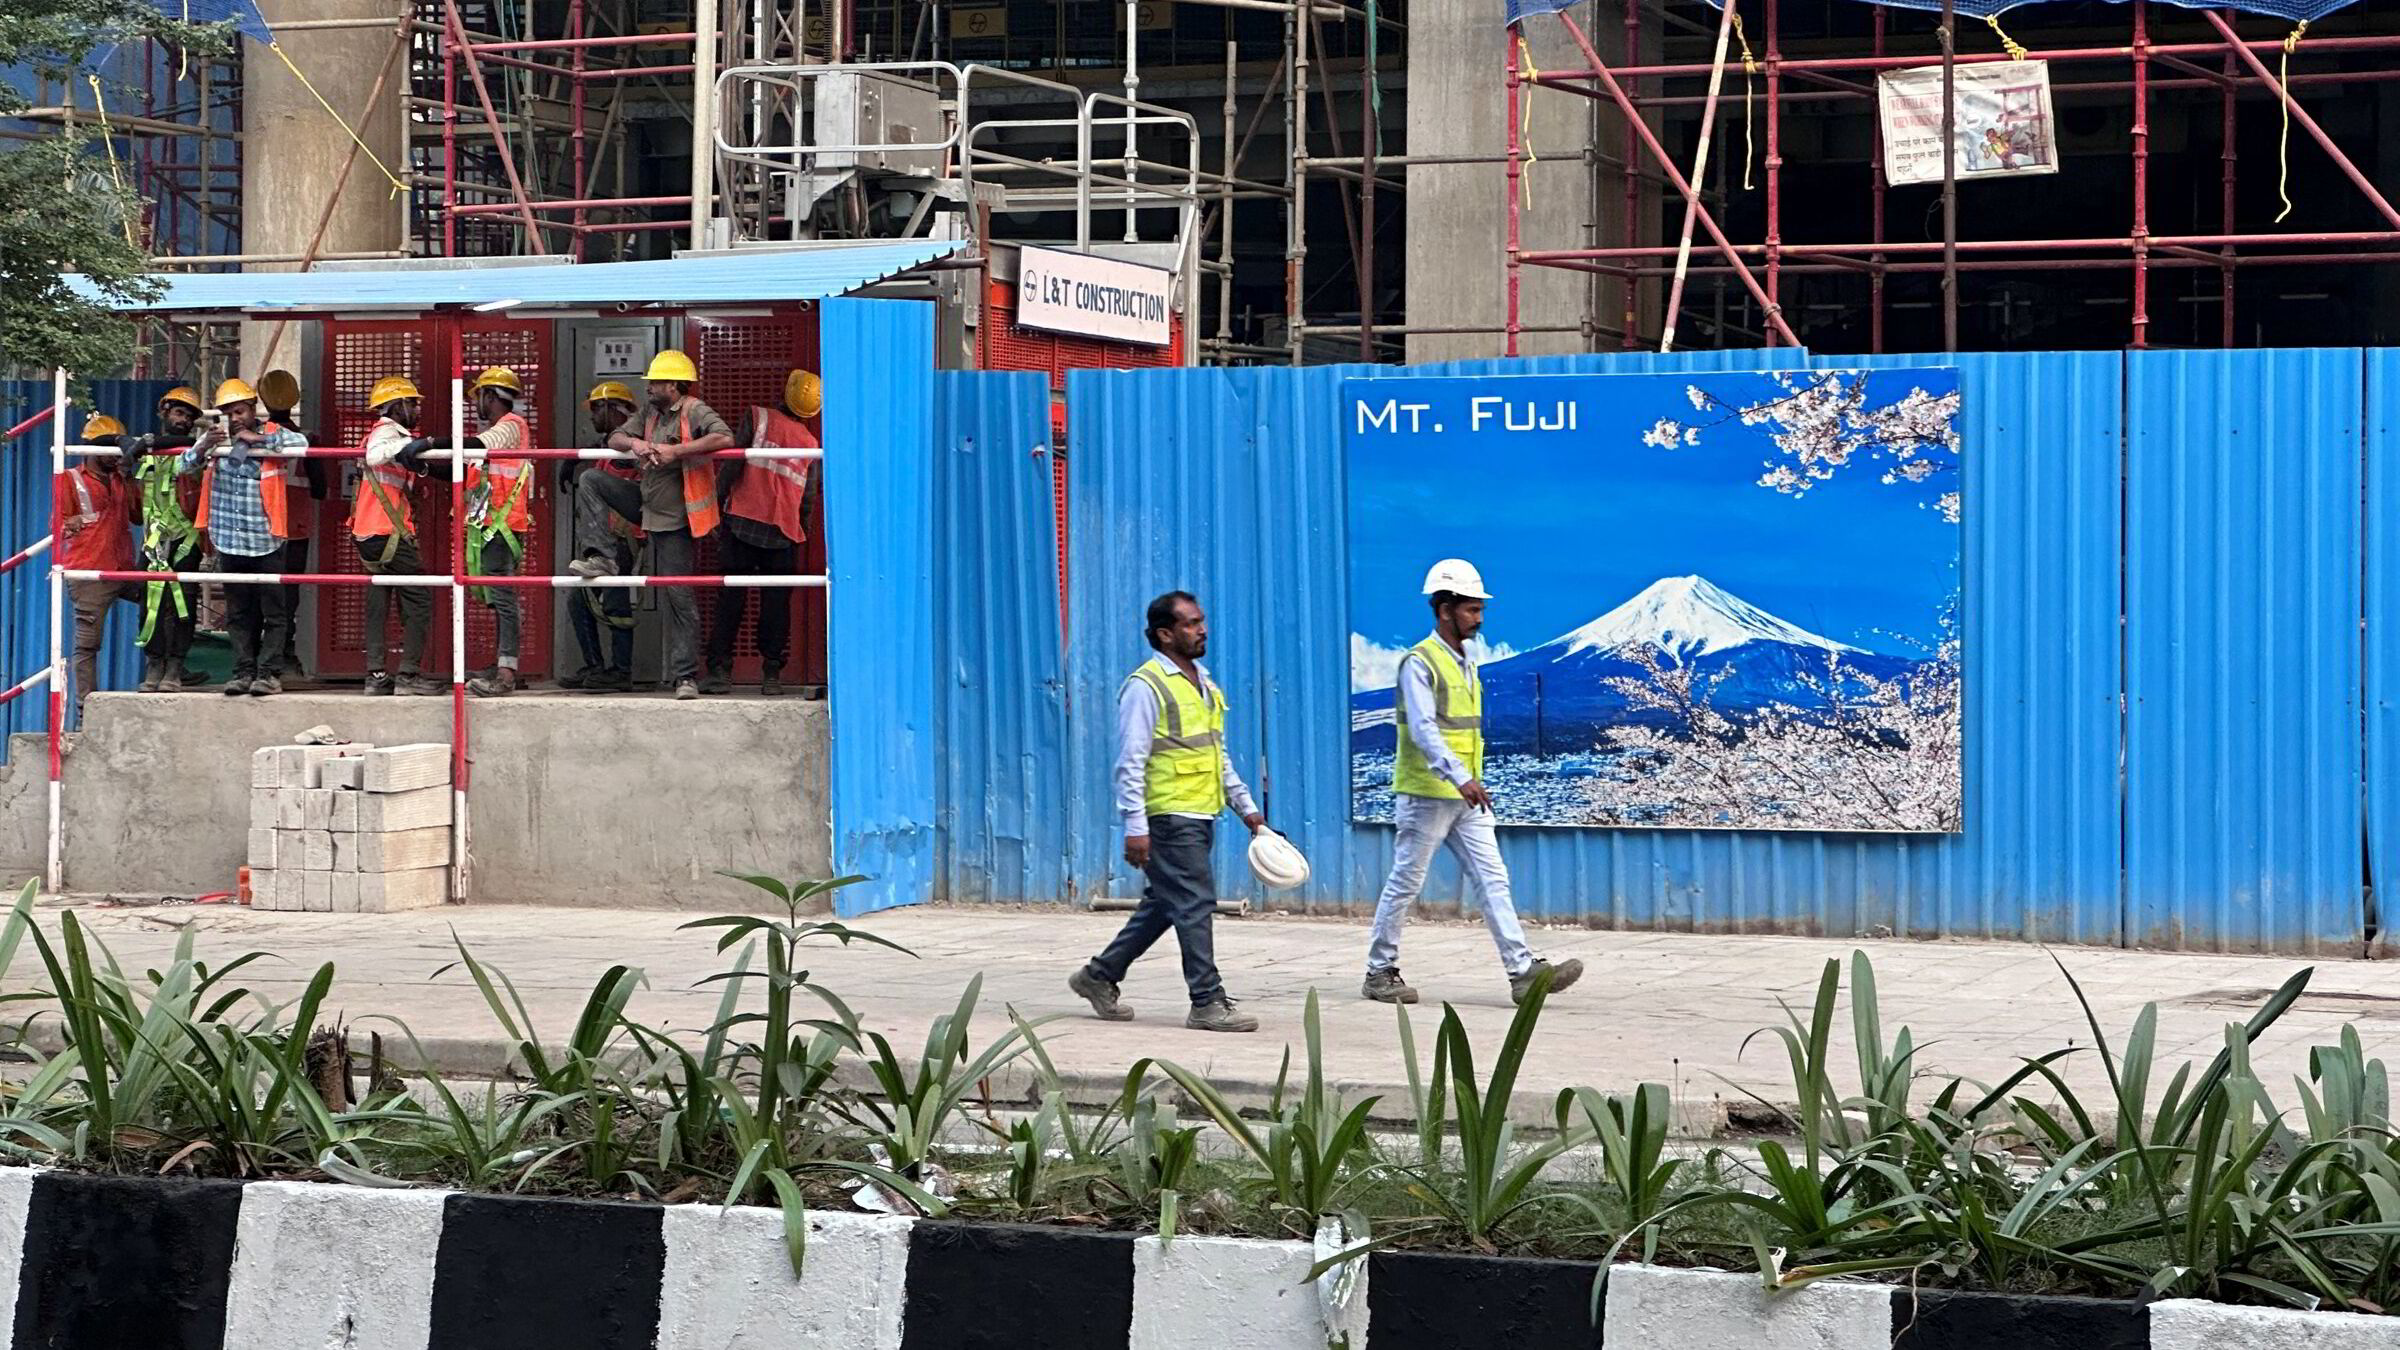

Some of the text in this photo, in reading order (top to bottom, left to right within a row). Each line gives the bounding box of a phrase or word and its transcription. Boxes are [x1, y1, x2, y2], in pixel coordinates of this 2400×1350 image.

[1043, 274, 1164, 323] L&T CONSTRUCTION
[1471, 396, 1577, 432] FUJI
